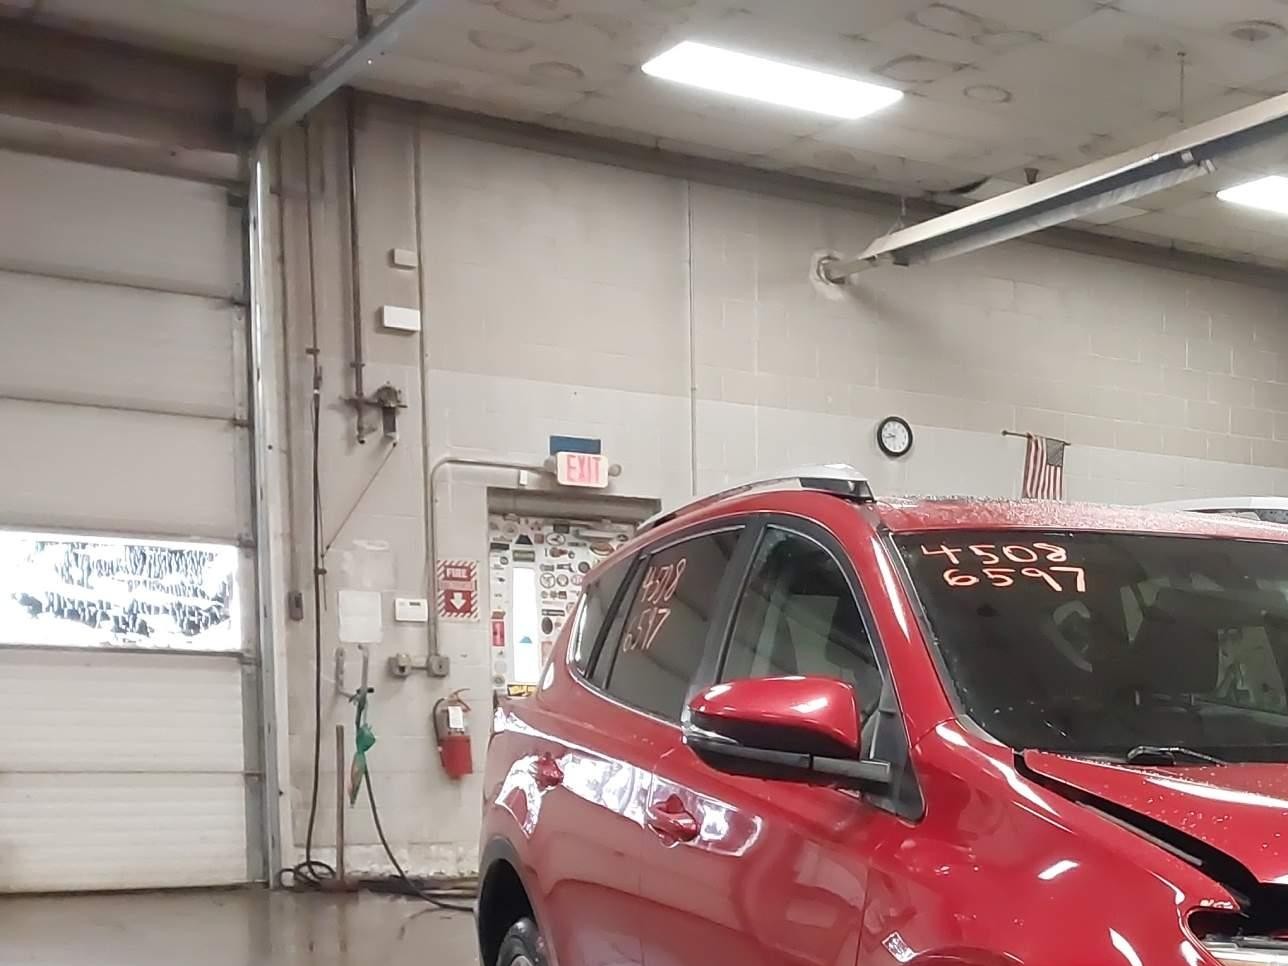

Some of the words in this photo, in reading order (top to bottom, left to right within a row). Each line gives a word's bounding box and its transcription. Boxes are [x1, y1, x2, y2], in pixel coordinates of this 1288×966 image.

[566, 455, 602, 484] EXIT
[920, 542, 1068, 565] 4508
[943, 567, 1087, 593] 6597
